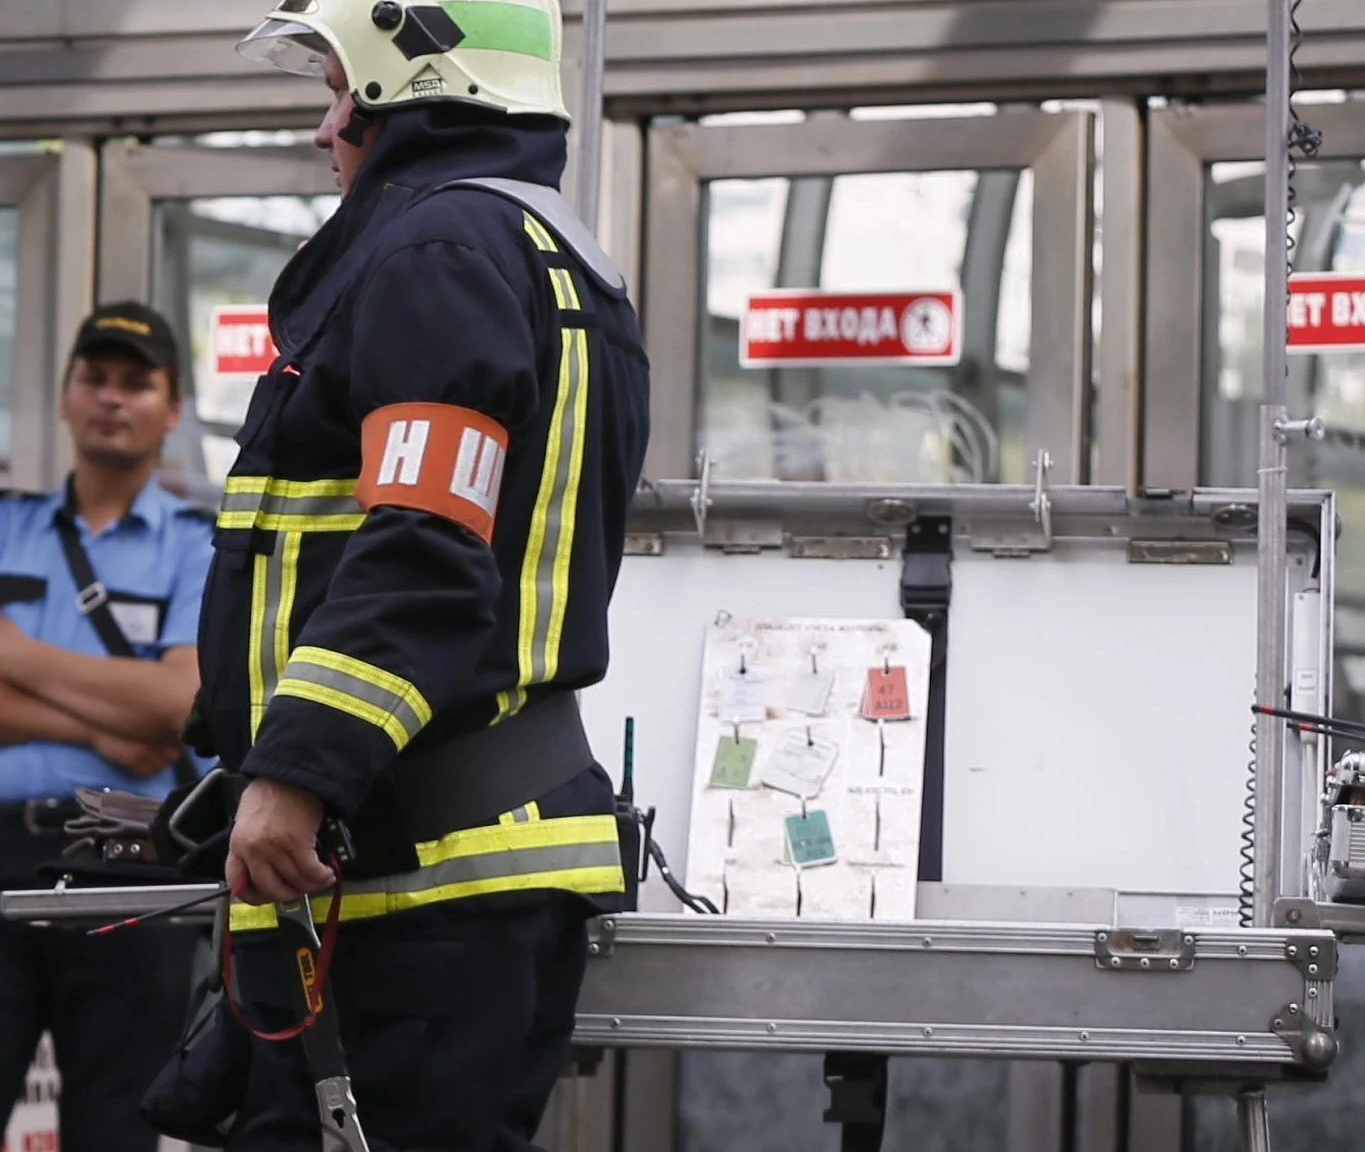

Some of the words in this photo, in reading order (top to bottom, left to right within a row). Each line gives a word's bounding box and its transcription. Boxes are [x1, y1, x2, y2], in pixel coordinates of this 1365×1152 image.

[748, 307, 800, 343] НЕТ
[802, 305, 898, 346] ВХОДА
[1287, 292, 1327, 328] ЕТ
[215, 323, 269, 358] НЕТ
